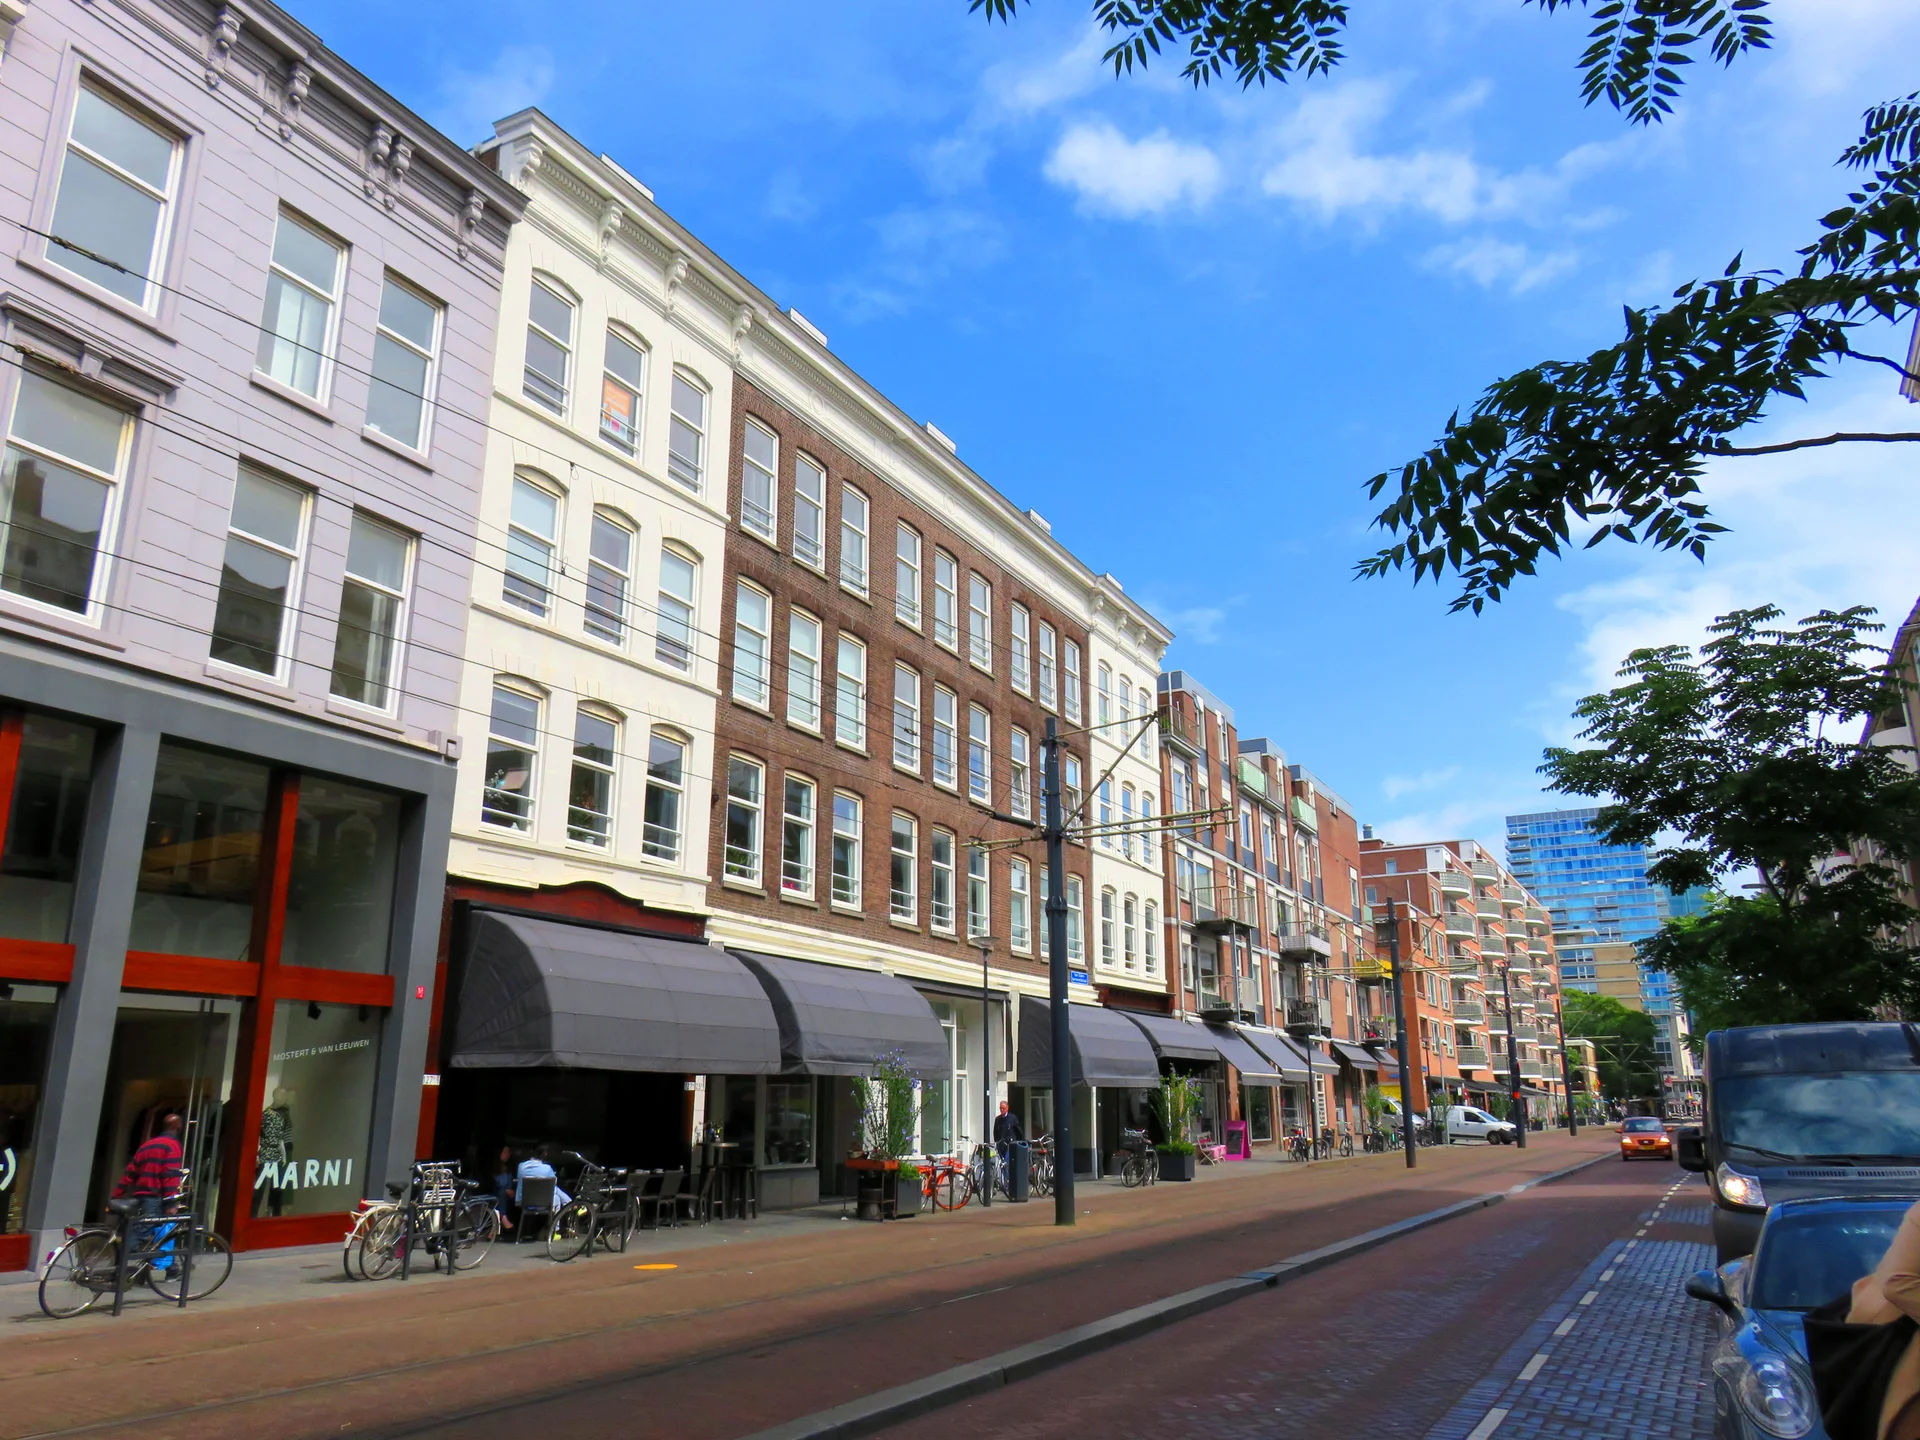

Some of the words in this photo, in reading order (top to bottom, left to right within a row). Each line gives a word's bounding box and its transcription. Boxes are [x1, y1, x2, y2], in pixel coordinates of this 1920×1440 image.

[273, 1048, 310, 1061] MOSTERT
[311, 1047, 317, 1055] &
[318, 1045, 333, 1054] VAN
[334, 1039, 370, 1051] LEEUWEN
[253, 1158, 353, 1190] MARNI
